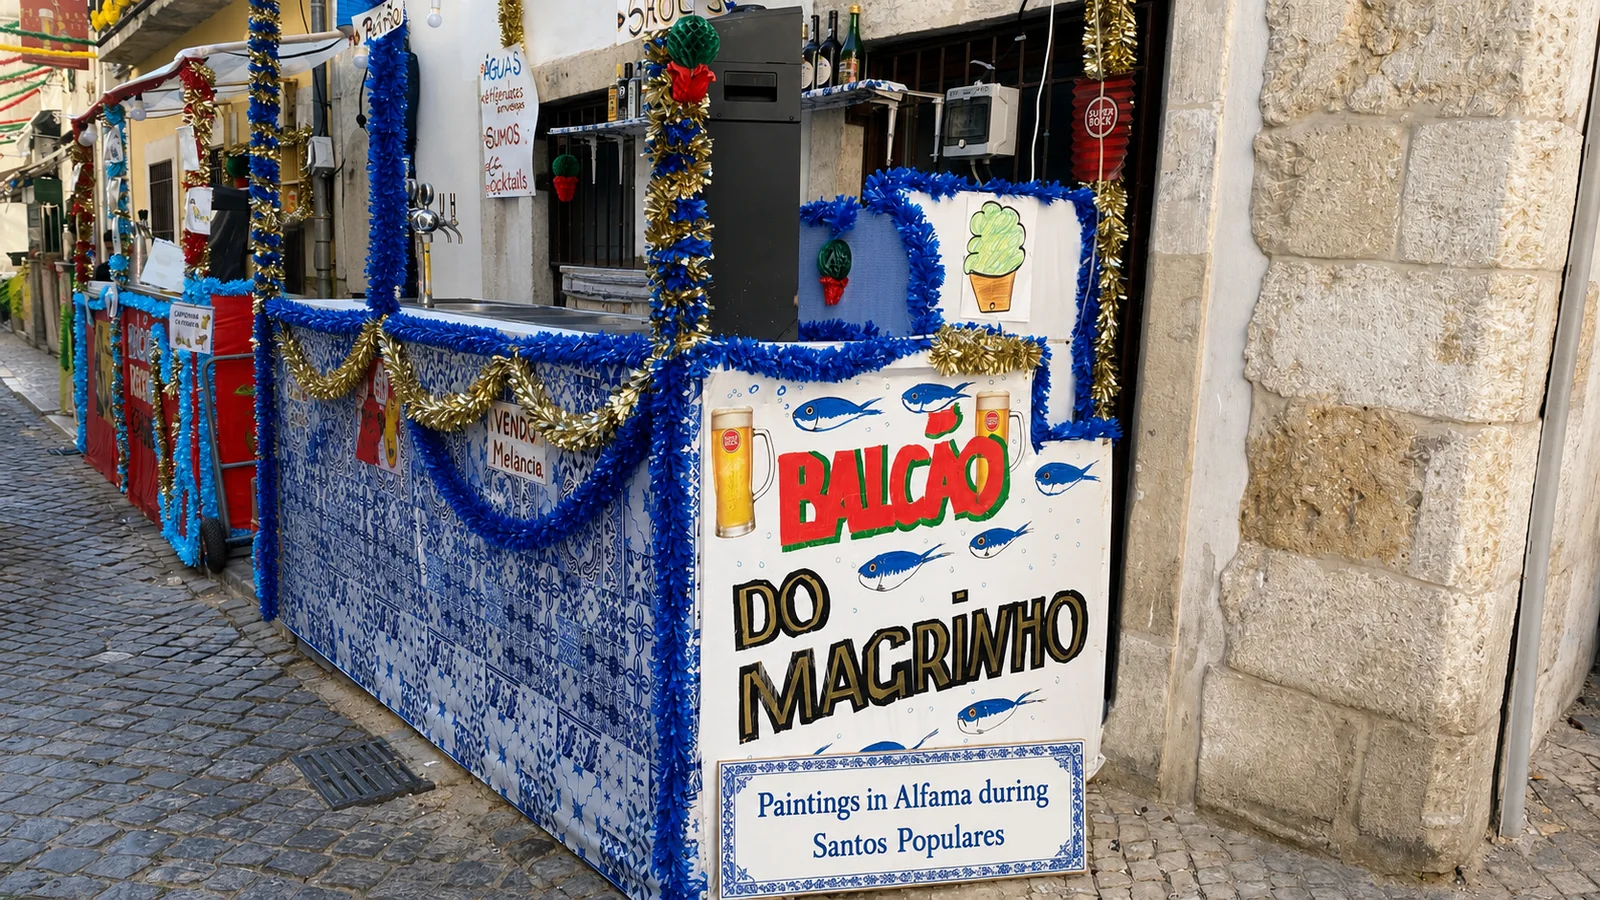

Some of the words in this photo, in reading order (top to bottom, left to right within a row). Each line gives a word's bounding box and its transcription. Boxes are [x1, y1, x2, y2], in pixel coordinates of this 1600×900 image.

[485, 123, 520, 149] SUMOS
[494, 408, 537, 443] VENDO
[733, 568, 831, 651] DO
[757, 789, 860, 821] Paintings
[866, 788, 888, 811] in
[893, 782, 973, 810] Alfama
[978, 778, 1049, 809] during
[812, 831, 888, 859] Santos
[897, 823, 1005, 858] Populares
